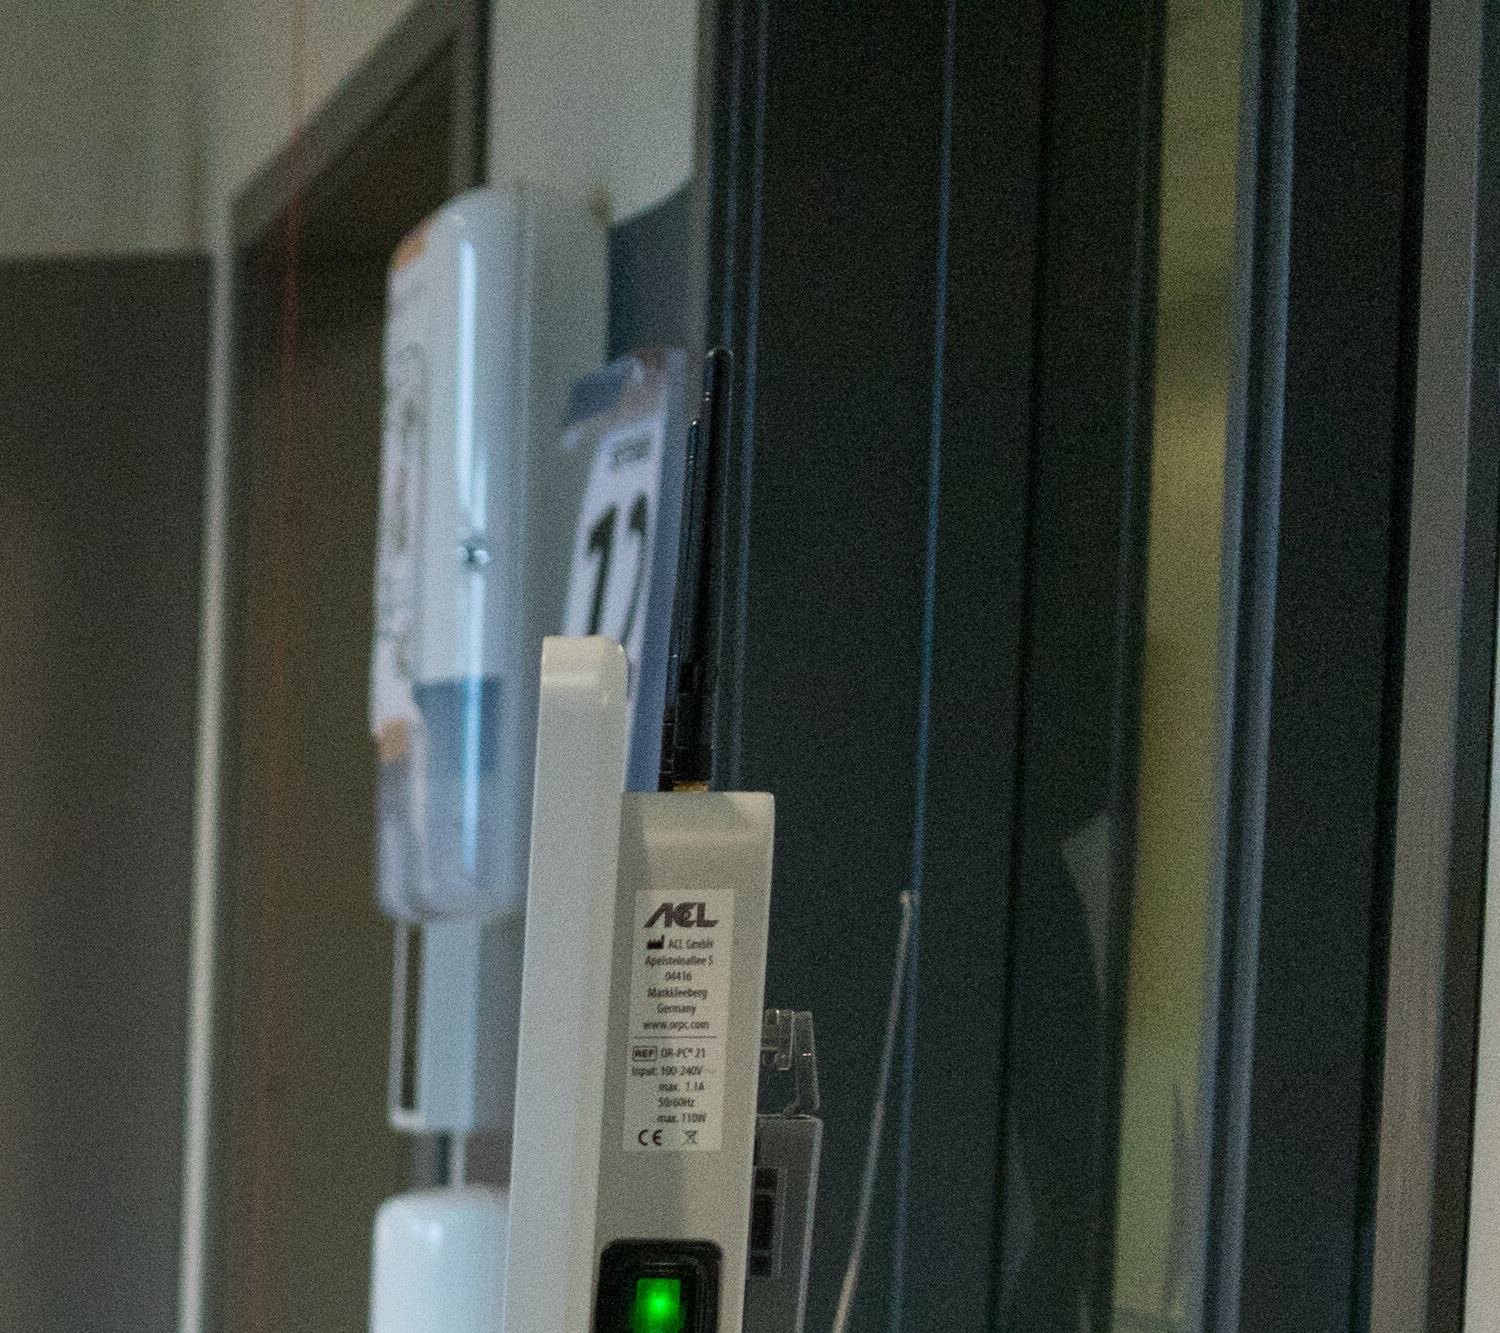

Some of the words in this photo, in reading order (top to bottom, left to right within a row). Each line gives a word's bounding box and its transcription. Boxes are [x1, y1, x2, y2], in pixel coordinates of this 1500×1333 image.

[687, 938, 714, 950] GmbH
[665, 971, 693, 981] 04416
[647, 987, 708, 1000] Markkleeberg
[657, 1003, 697, 1016] Germany
[643, 1021, 710, 1031] www.orpc.com
